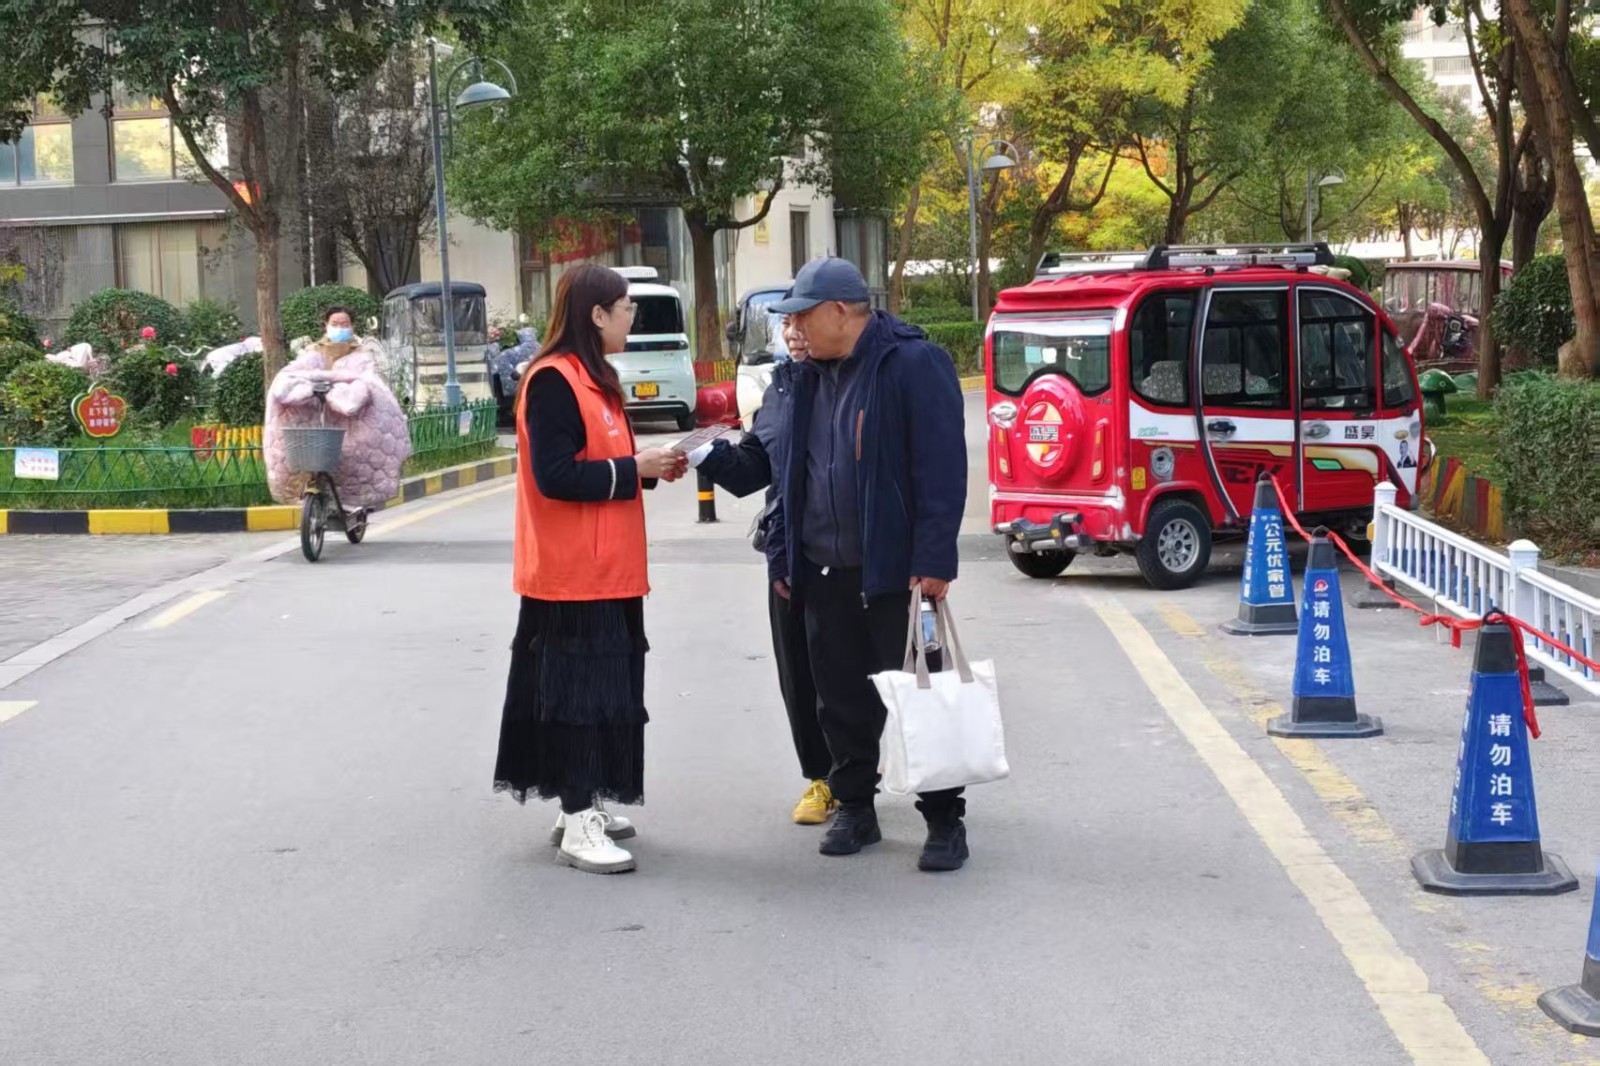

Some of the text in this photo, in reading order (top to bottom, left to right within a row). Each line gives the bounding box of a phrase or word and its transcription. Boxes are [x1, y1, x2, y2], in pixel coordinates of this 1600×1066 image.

[1313, 600, 1331, 686] 请勿泊车
[1488, 713, 1513, 827] 请勿泊车
